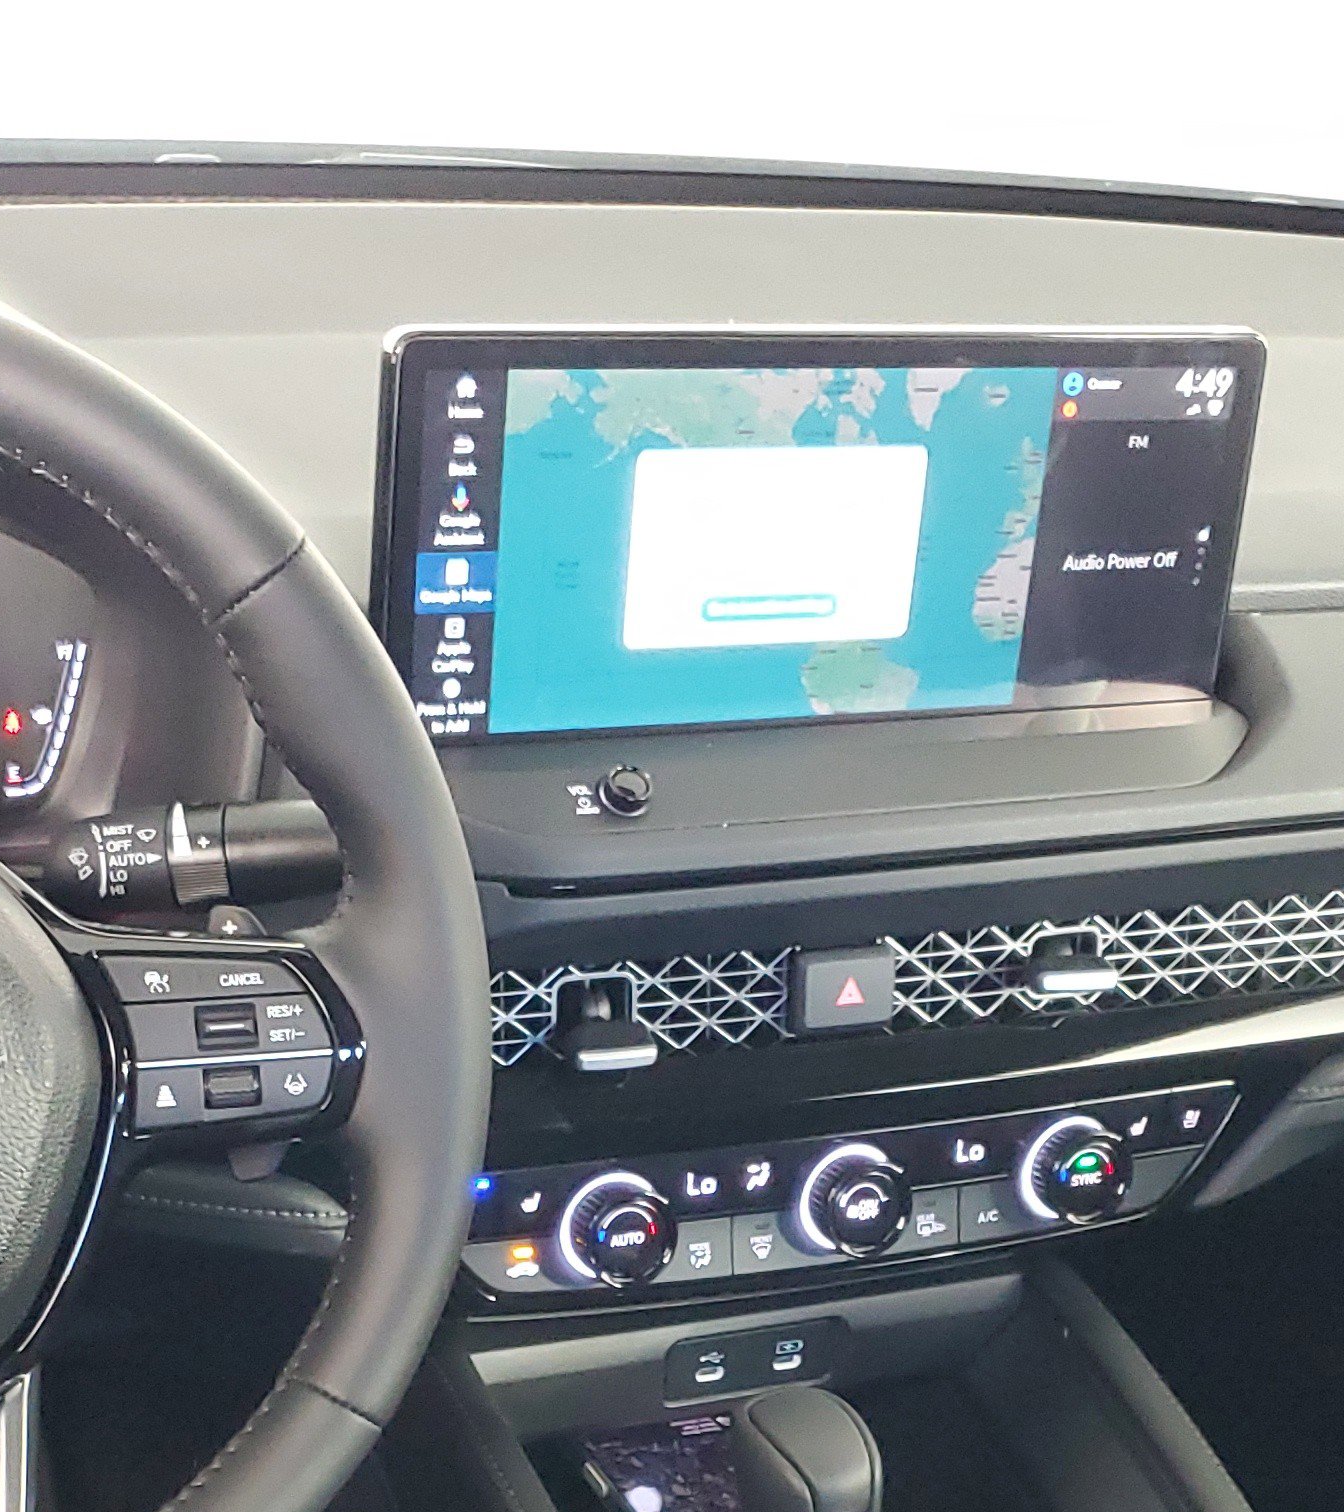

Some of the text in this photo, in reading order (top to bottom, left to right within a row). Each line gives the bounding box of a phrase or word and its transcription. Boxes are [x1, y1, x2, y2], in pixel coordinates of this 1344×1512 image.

[1175, 368, 1233, 397] 4:49
[1128, 434, 1149, 449] FM
[1063, 550, 1179, 572] Audio Power Off
[103, 824, 134, 837] MIST
[106, 840, 132, 853] OFF
[109, 853, 146, 867] AUTO
[109, 871, 128, 883] LO
[110, 885, 126, 896] HI
[219, 972, 265, 987] CANCEL
[1070, 1171, 1103, 1187] SYNC
[978, 1209, 1000, 1224] A/C
[610, 1230, 646, 1248] AUTO
